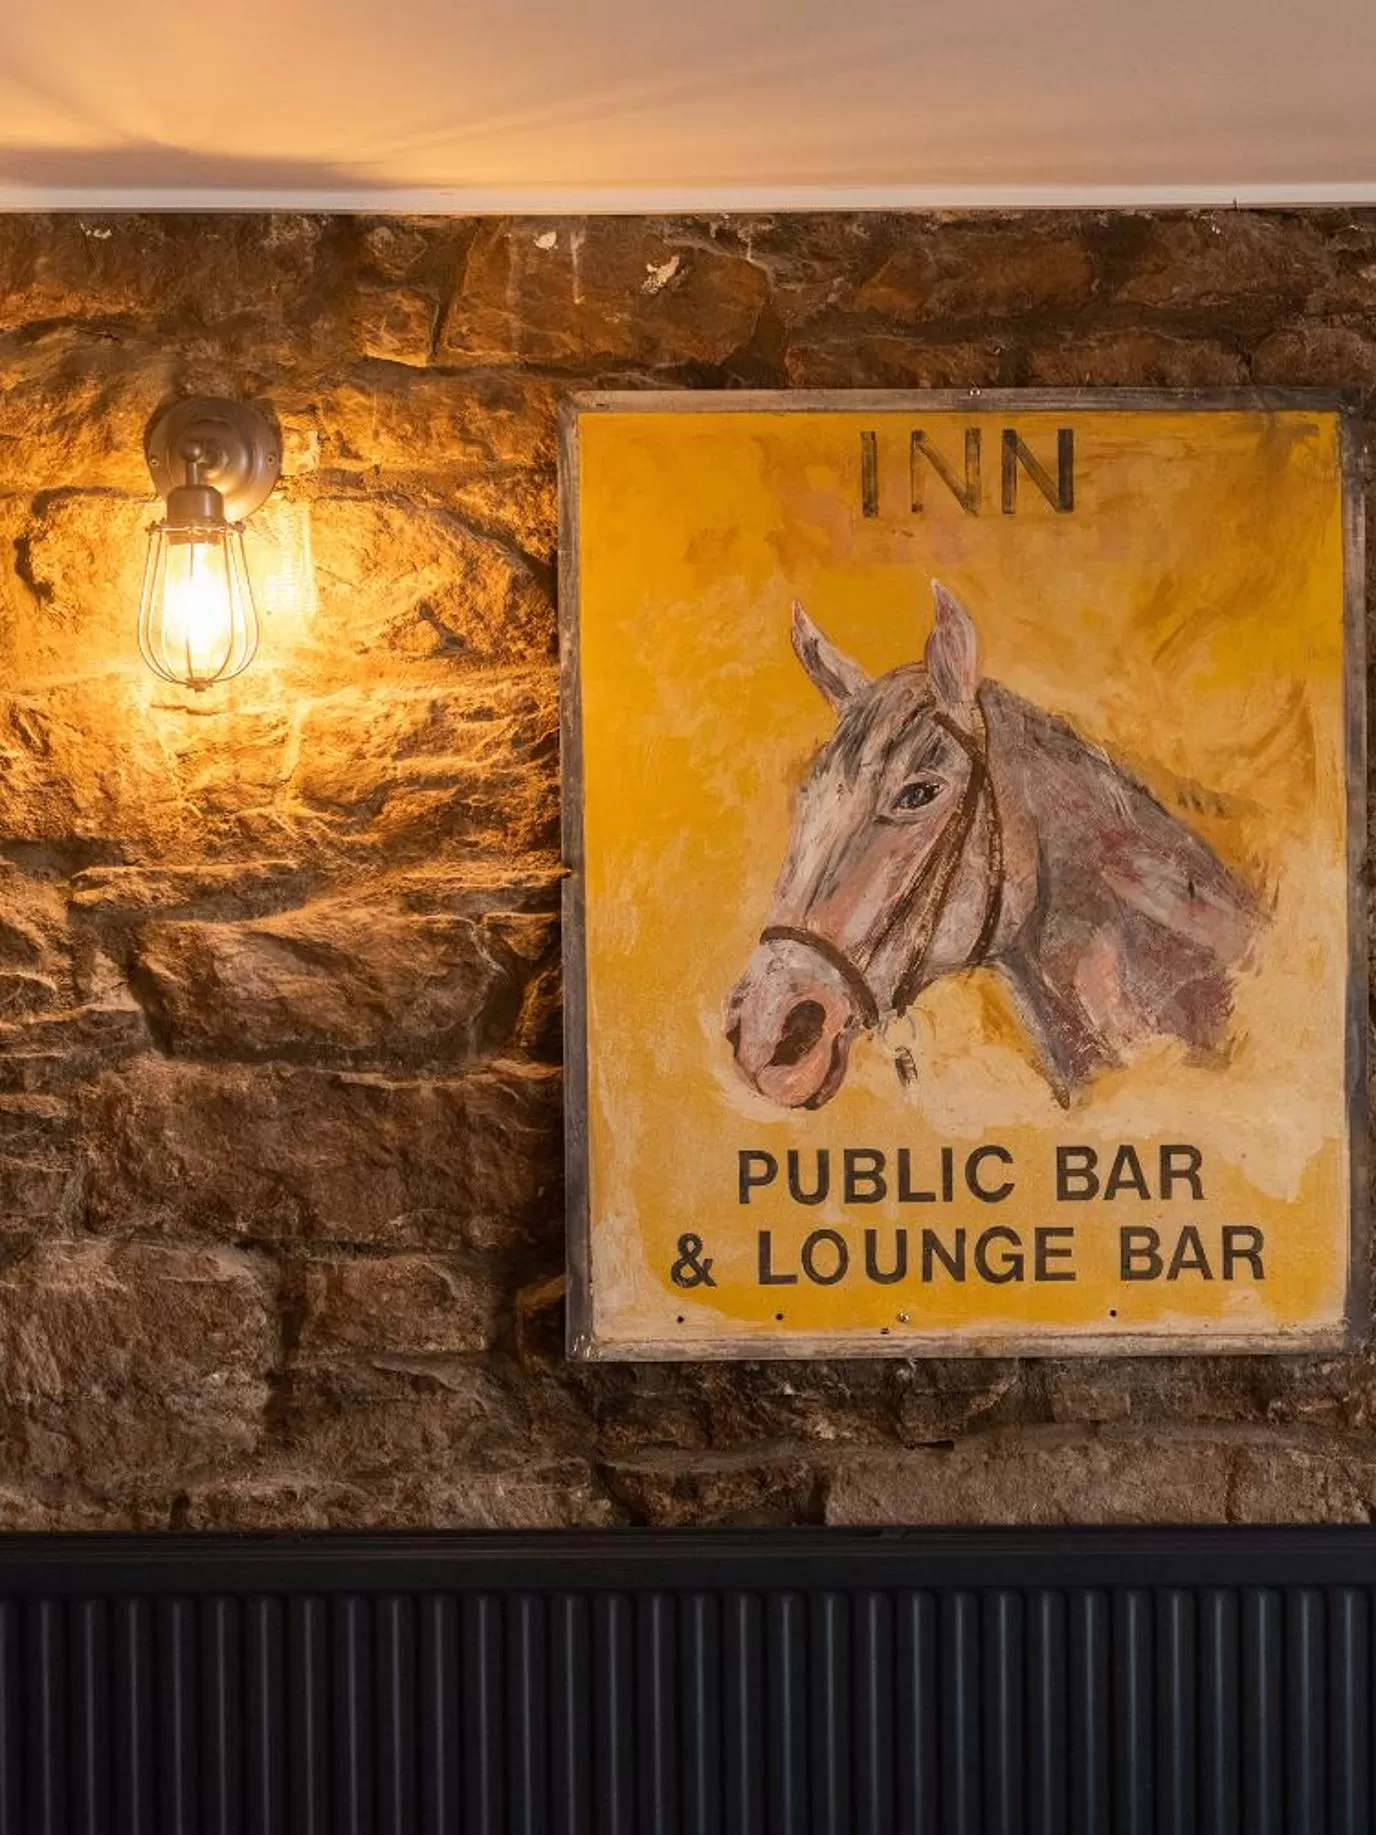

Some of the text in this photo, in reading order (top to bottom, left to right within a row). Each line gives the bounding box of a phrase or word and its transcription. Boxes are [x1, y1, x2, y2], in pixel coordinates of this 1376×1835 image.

[860, 427, 1074, 517] INN
[738, 1144, 1206, 1205] PUBLIC BAR
[670, 1225, 1265, 1287] & LOUNGE BAR
